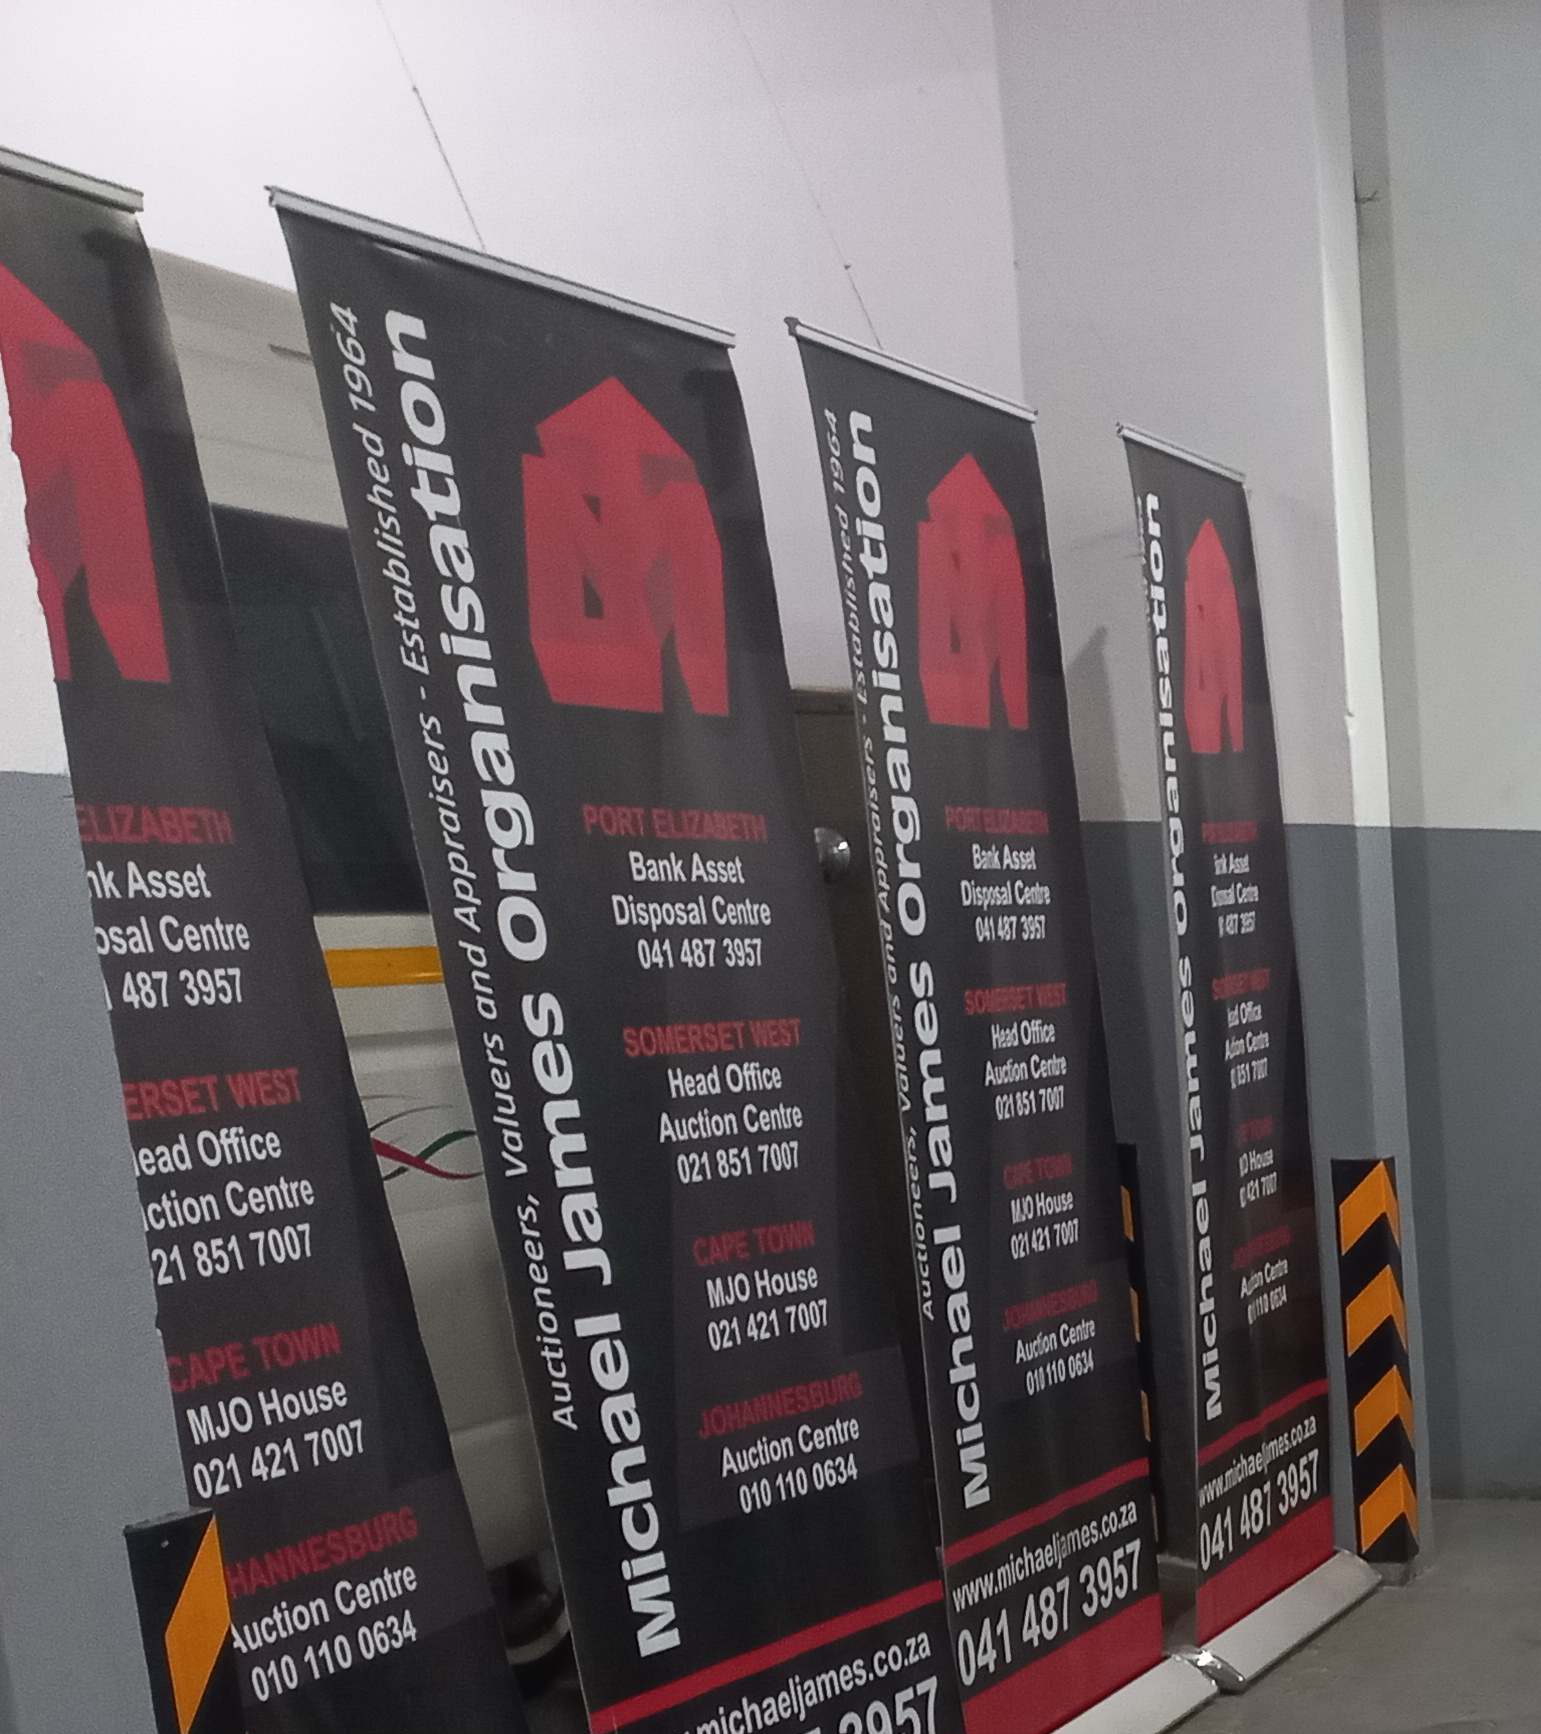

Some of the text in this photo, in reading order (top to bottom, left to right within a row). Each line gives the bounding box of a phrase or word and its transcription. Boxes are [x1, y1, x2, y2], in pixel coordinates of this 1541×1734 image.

[328, 302, 376, 412] 1964
[824, 407, 846, 495] 1964
[353, 419, 431, 676] Established
[834, 503, 867, 705] Established
[420, 712, 482, 933] Appraisers
[582, 804, 768, 844] PORT ELIZABETH
[127, 861, 212, 899] Asset
[628, 851, 745, 884] Bank Asset
[1003, 844, 1037, 871] Asset
[611, 894, 771, 933] Disposal Centre
[960, 879, 1051, 911] Disposal Centre
[159, 914, 251, 953] Centre
[637, 938, 762, 970] 041 487 3957
[879, 919, 897, 985] and
[384, 309, 681, 1657] Michael James Organisation
[459, 941, 498, 1020] and
[849, 410, 991, 1509] Michael James Organisation
[122, 971, 169, 1010] 487
[178, 967, 243, 1007] 3957
[623, 1018, 801, 1057] SOMERSET WEST
[991, 1019, 1056, 1050] Head Office
[226, 1067, 301, 1109] WEST
[667, 1062, 782, 1099] Head Office
[1031, 1054, 1067, 1079] Centre
[483, 1032, 528, 1177] Valuers
[659, 1102, 803, 1144] Auction Centre
[1015, 1091, 1037, 1117] 851
[197, 1127, 282, 1168] Office
[677, 1141, 799, 1184] 021 851 7007
[225, 1176, 315, 1218] Centre
[1036, 1191, 1074, 1216] House
[151, 1223, 313, 1286] 21 851 7007
[693, 1219, 816, 1266] CAPE TOWN
[1010, 1232, 1030, 1261] 021
[1030, 1226, 1051, 1253] 421
[706, 1266, 818, 1309] MJO House
[1191, 1179, 1223, 1421] Michael
[516, 1193, 578, 1430] Auctioneers,
[707, 1299, 828, 1352] 021 421 7007
[166, 1322, 342, 1393] CAPE TOWN
[1015, 1318, 1096, 1365] Auction Centre
[1046, 1360, 1066, 1387] 110
[1068, 1347, 1095, 1379] 0634
[187, 1380, 348, 1446] MJO House
[193, 1419, 365, 1500] 021 421 7007
[720, 1415, 861, 1479] Auction Centre
[739, 1453, 858, 1515] 010 110 0634
[1200, 1448, 1319, 1571] 041 487 3957
[951, 1500, 1138, 1614] www.michaeljames.co.za
[231, 1564, 418, 1655] Auction Centre
[956, 1537, 1142, 1687] 041 487 3957
[251, 1609, 417, 1703] 010 110 0634
